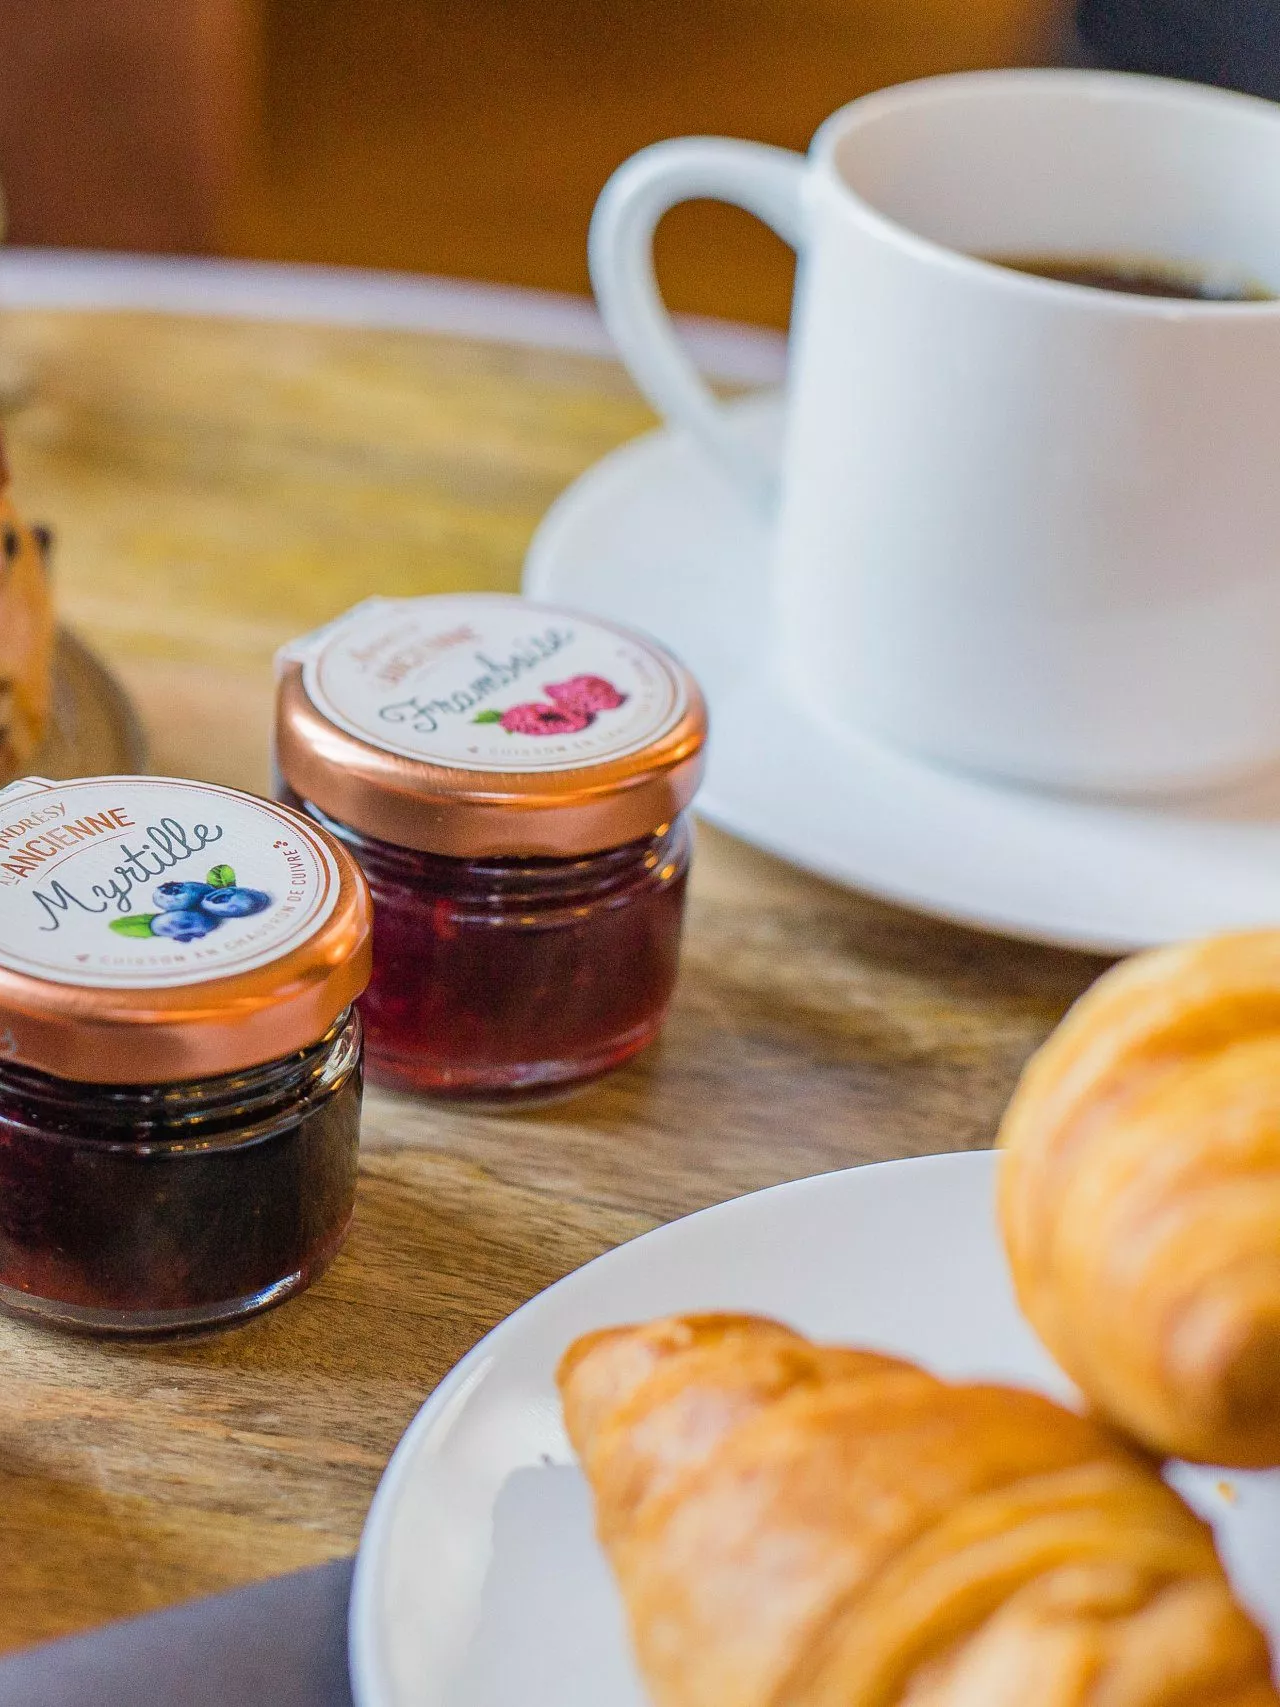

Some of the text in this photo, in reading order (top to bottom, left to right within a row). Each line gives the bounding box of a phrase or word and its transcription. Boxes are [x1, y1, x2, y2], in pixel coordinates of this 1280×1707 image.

[0, 807, 136, 878] ANCIENNE
[283, 848, 307, 887] CUIVRE
[32, 816, 223, 931] Myrtille
[286, 889, 305, 902] DE
